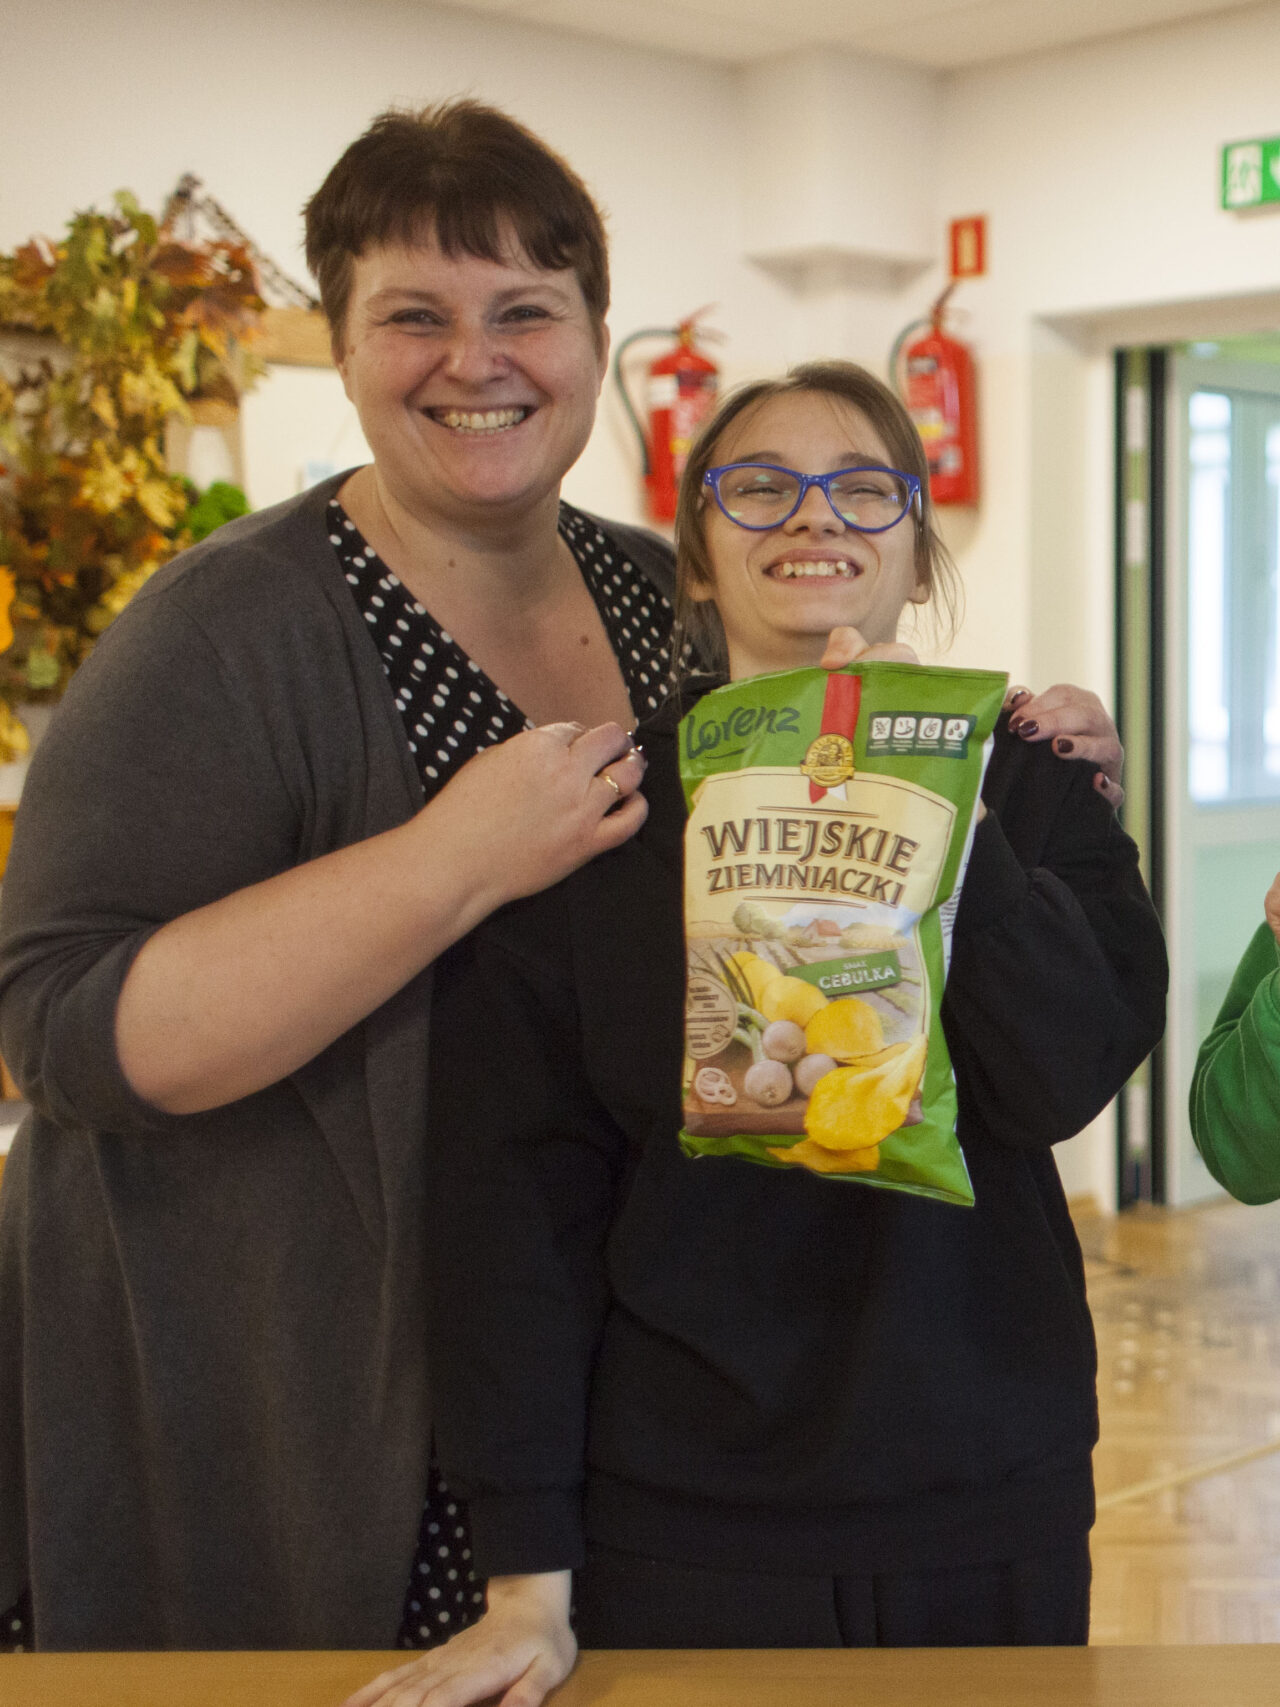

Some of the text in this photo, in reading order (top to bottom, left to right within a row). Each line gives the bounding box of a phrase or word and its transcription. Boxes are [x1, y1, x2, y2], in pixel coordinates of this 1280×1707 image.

[686, 706, 801, 760] Lorenz
[701, 817, 921, 877] WIEJSKIE
[706, 863, 907, 909] ZIEMNIACZKI
[818, 965, 897, 990] CEBULKA
